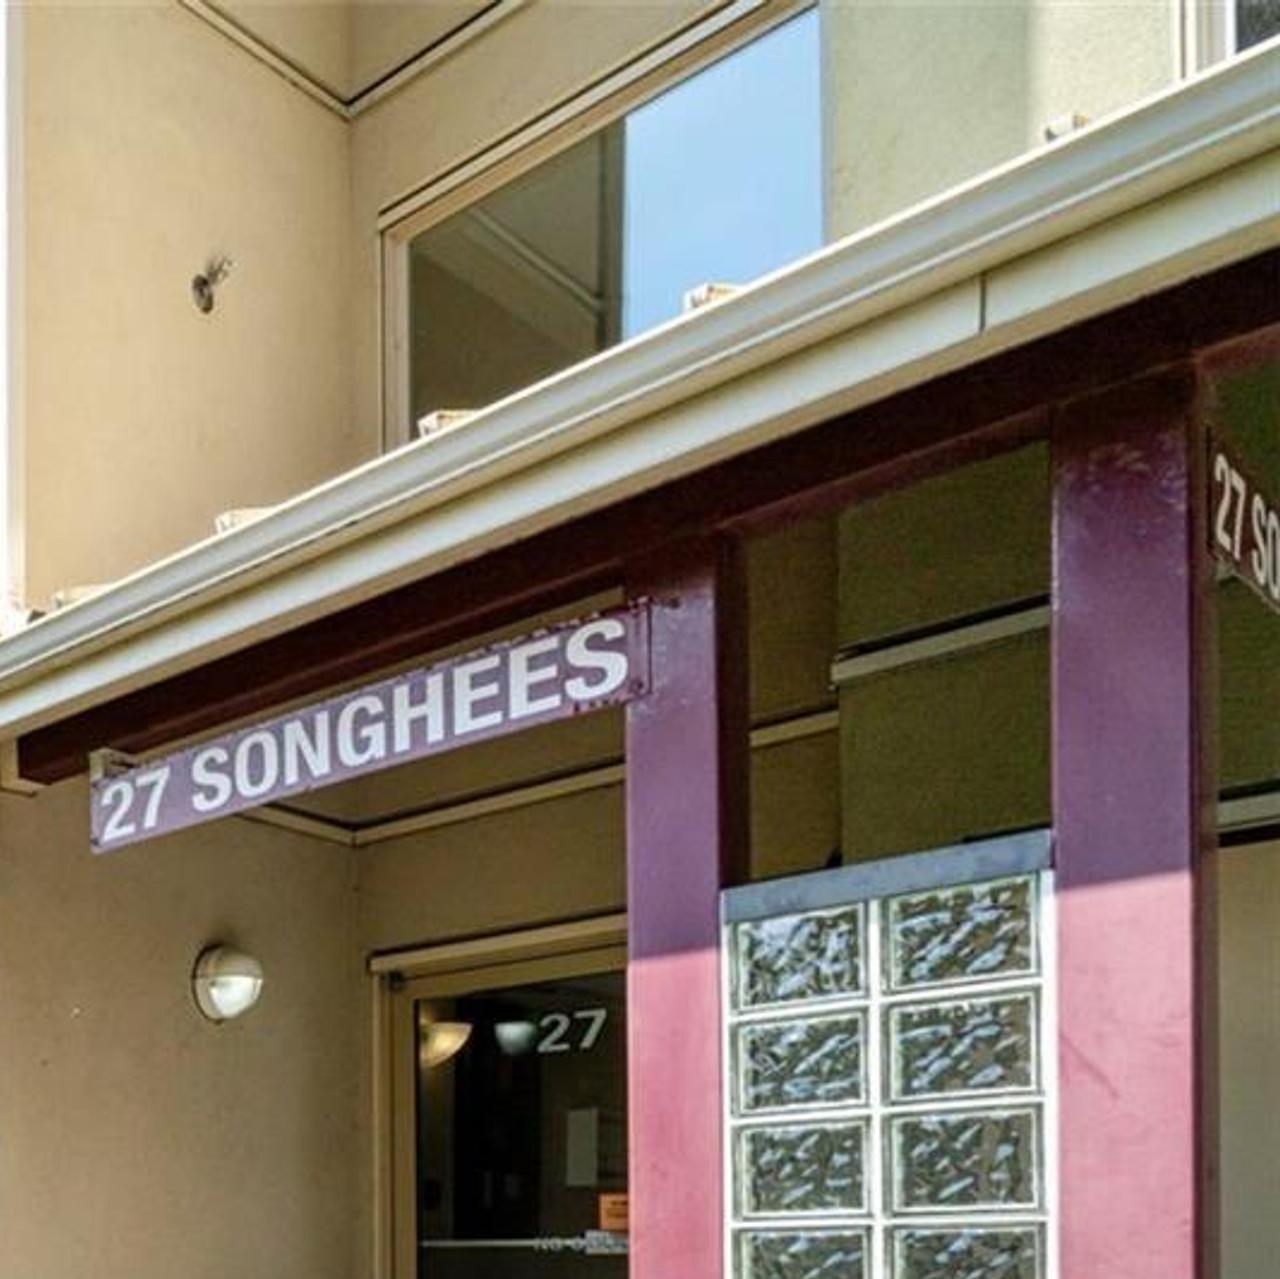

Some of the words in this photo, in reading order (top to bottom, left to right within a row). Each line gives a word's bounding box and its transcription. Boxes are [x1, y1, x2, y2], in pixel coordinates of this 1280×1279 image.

[1214, 453, 1246, 562] 27
[99, 767, 171, 843] 27
[191, 617, 630, 813] SONGHEES
[537, 1008, 608, 1053] 27
